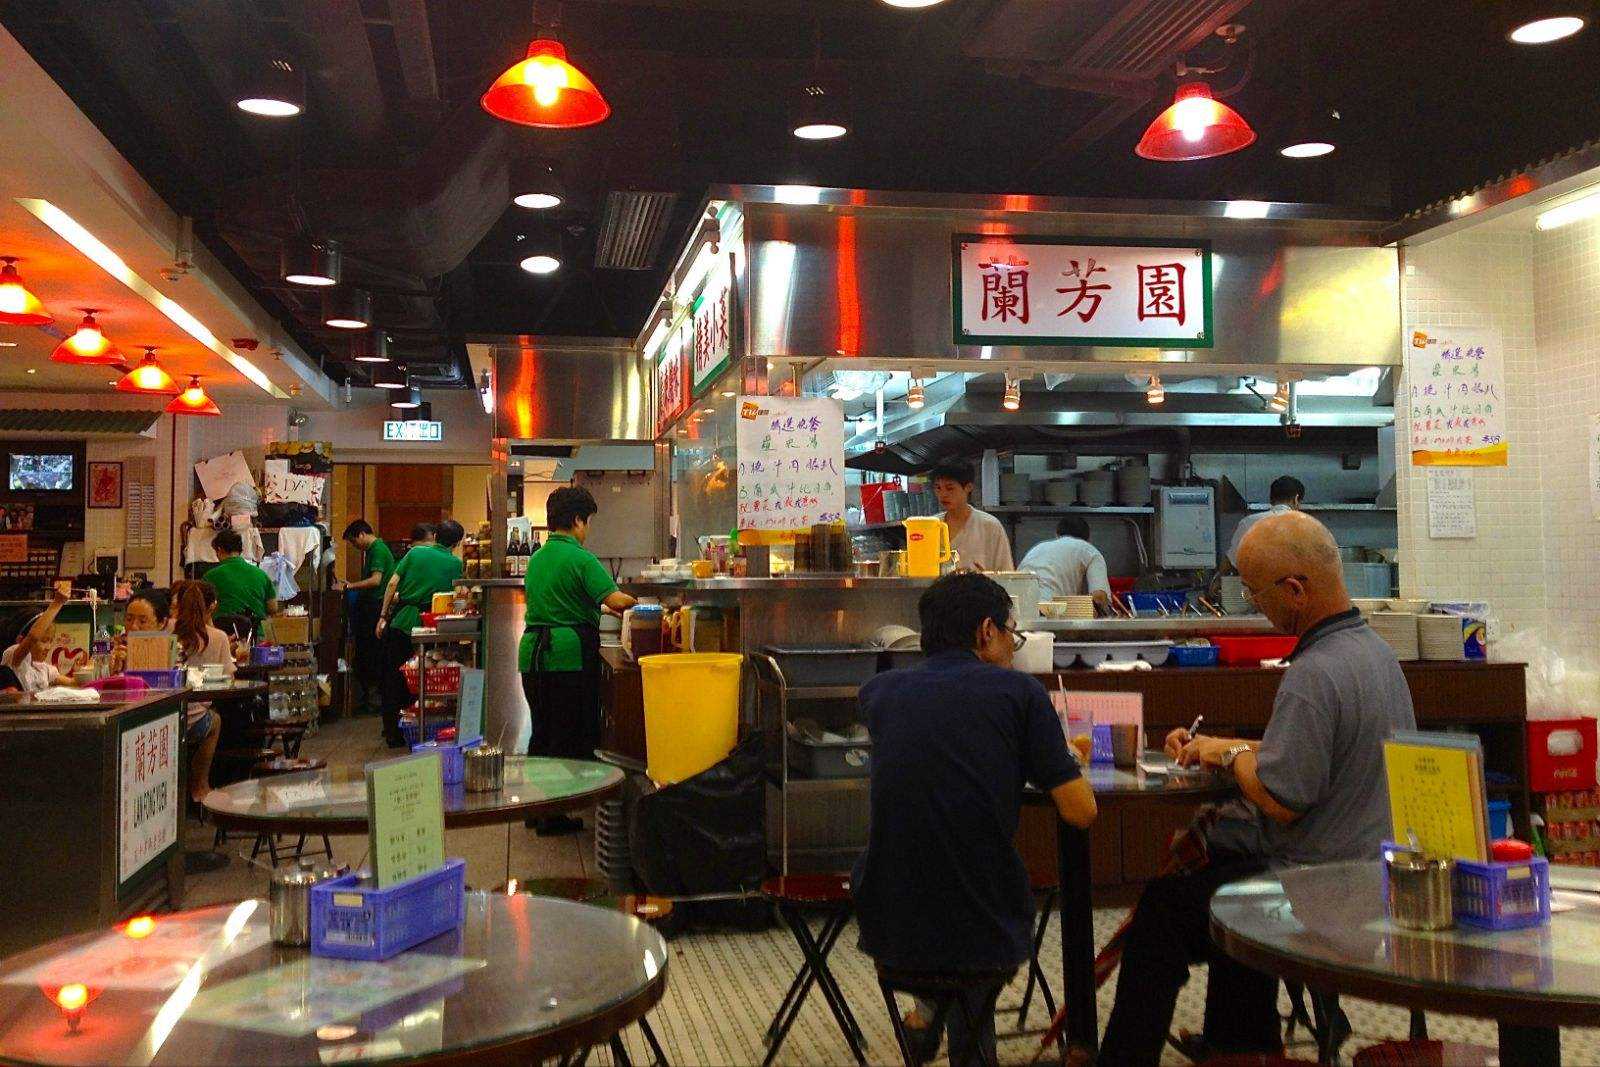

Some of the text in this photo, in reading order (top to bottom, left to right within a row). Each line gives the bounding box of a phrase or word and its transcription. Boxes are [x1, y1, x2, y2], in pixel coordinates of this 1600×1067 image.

[978, 255, 1186, 327] 蘭芳園
[387, 422, 416, 438] EXIT
[135, 725, 169, 782] 蘭芳園
